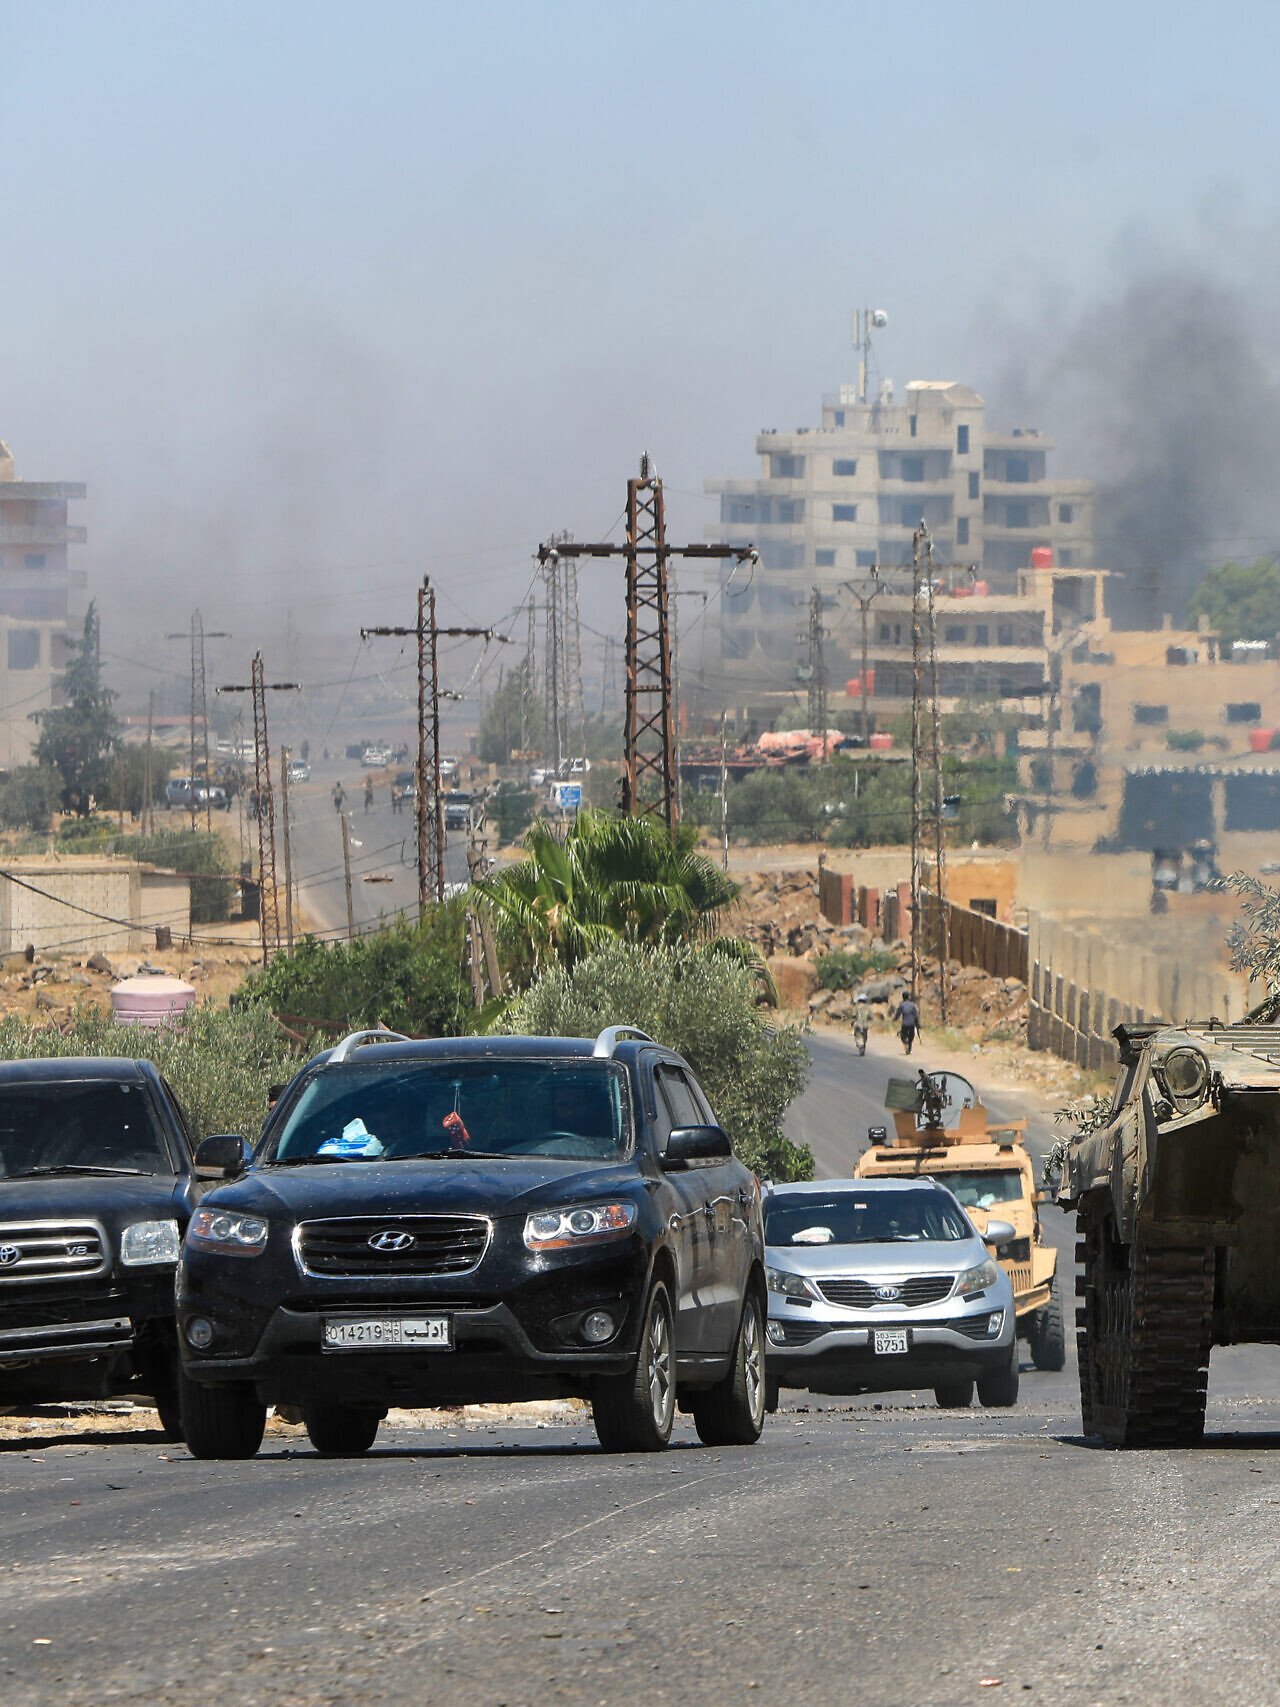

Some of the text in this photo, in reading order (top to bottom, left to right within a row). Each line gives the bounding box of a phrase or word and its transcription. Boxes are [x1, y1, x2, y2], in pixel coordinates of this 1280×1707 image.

[66, 1245, 88, 1257] V8
[879, 1288, 897, 1298] KIA
[329, 1324, 383, 1341] 014219
[877, 1339, 906, 1352] 8751
